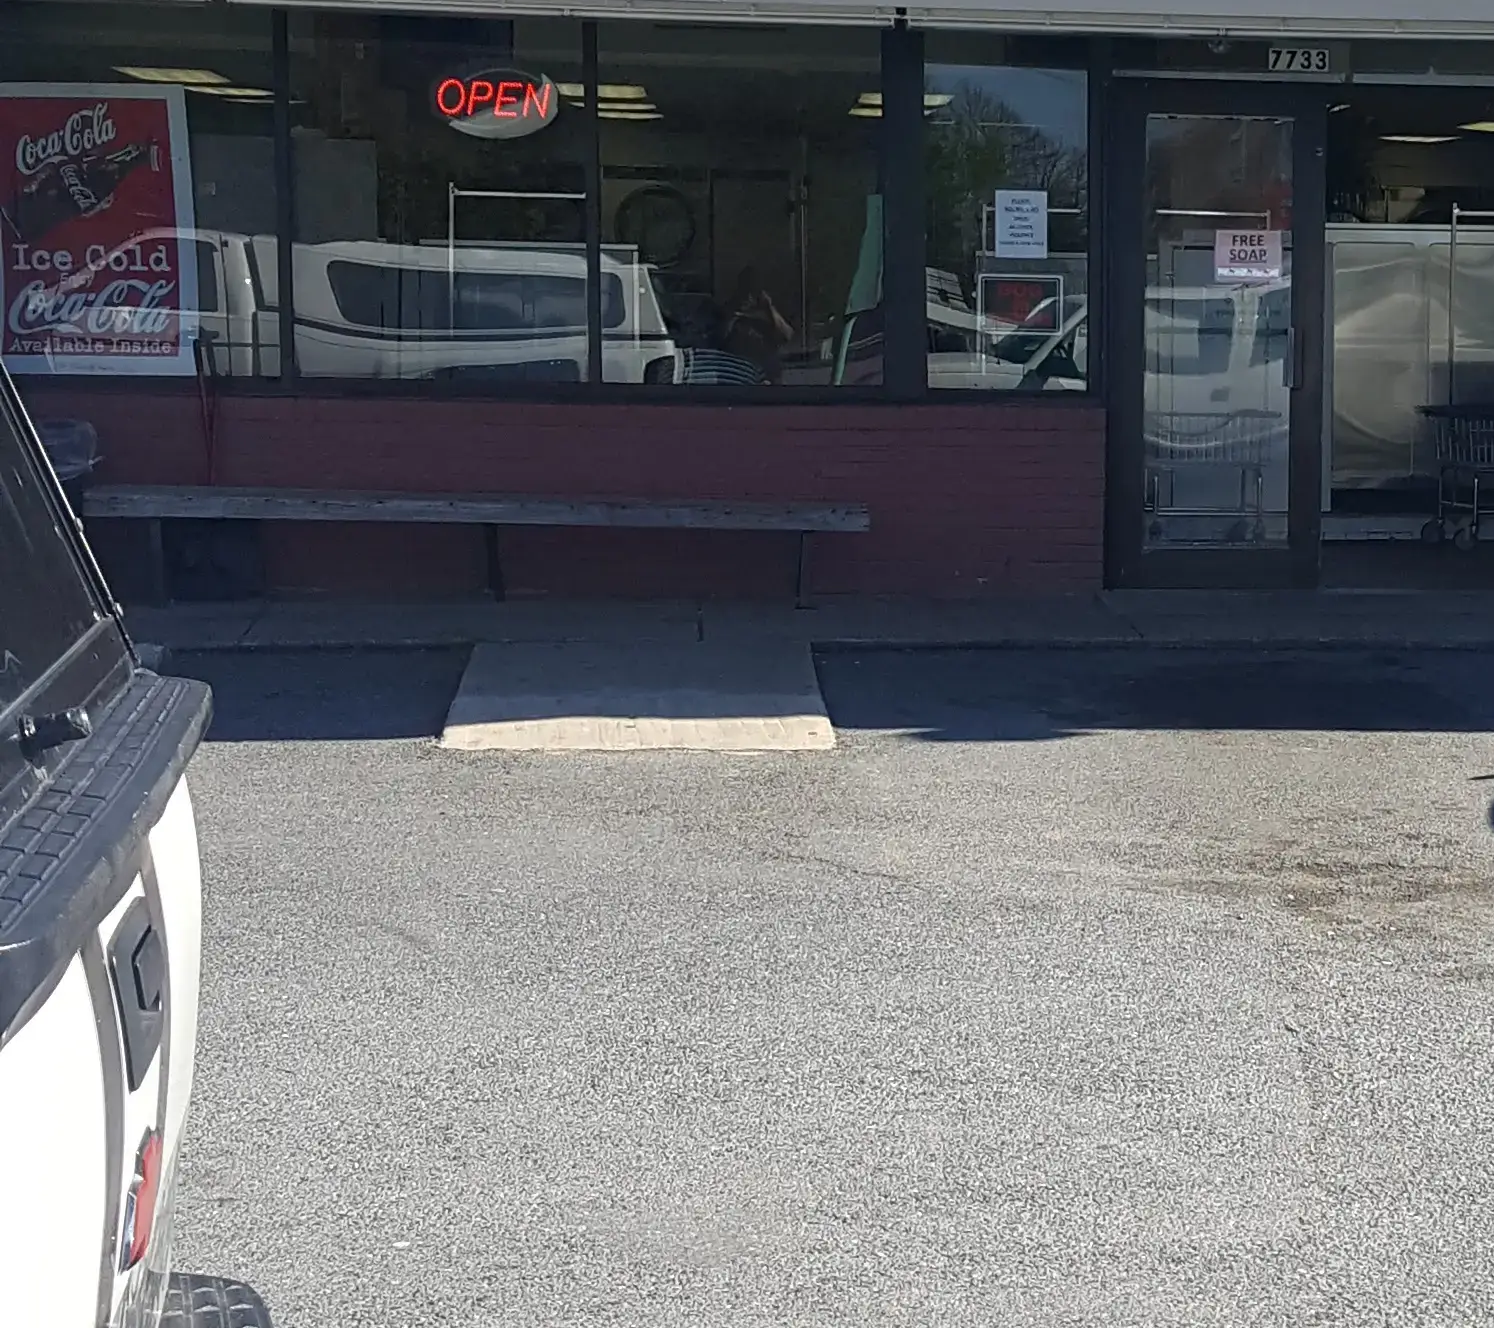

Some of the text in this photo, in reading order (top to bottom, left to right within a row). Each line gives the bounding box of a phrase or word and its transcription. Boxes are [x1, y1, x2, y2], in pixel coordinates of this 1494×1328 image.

[1271, 49, 1327, 70] 7733
[436, 77, 551, 119] OPEN
[1231, 234, 1265, 247] FREE
[12, 243, 172, 272] Ice Cold
[1228, 248, 1268, 262] SOAP
[9, 337, 172, 354] Available Inside
